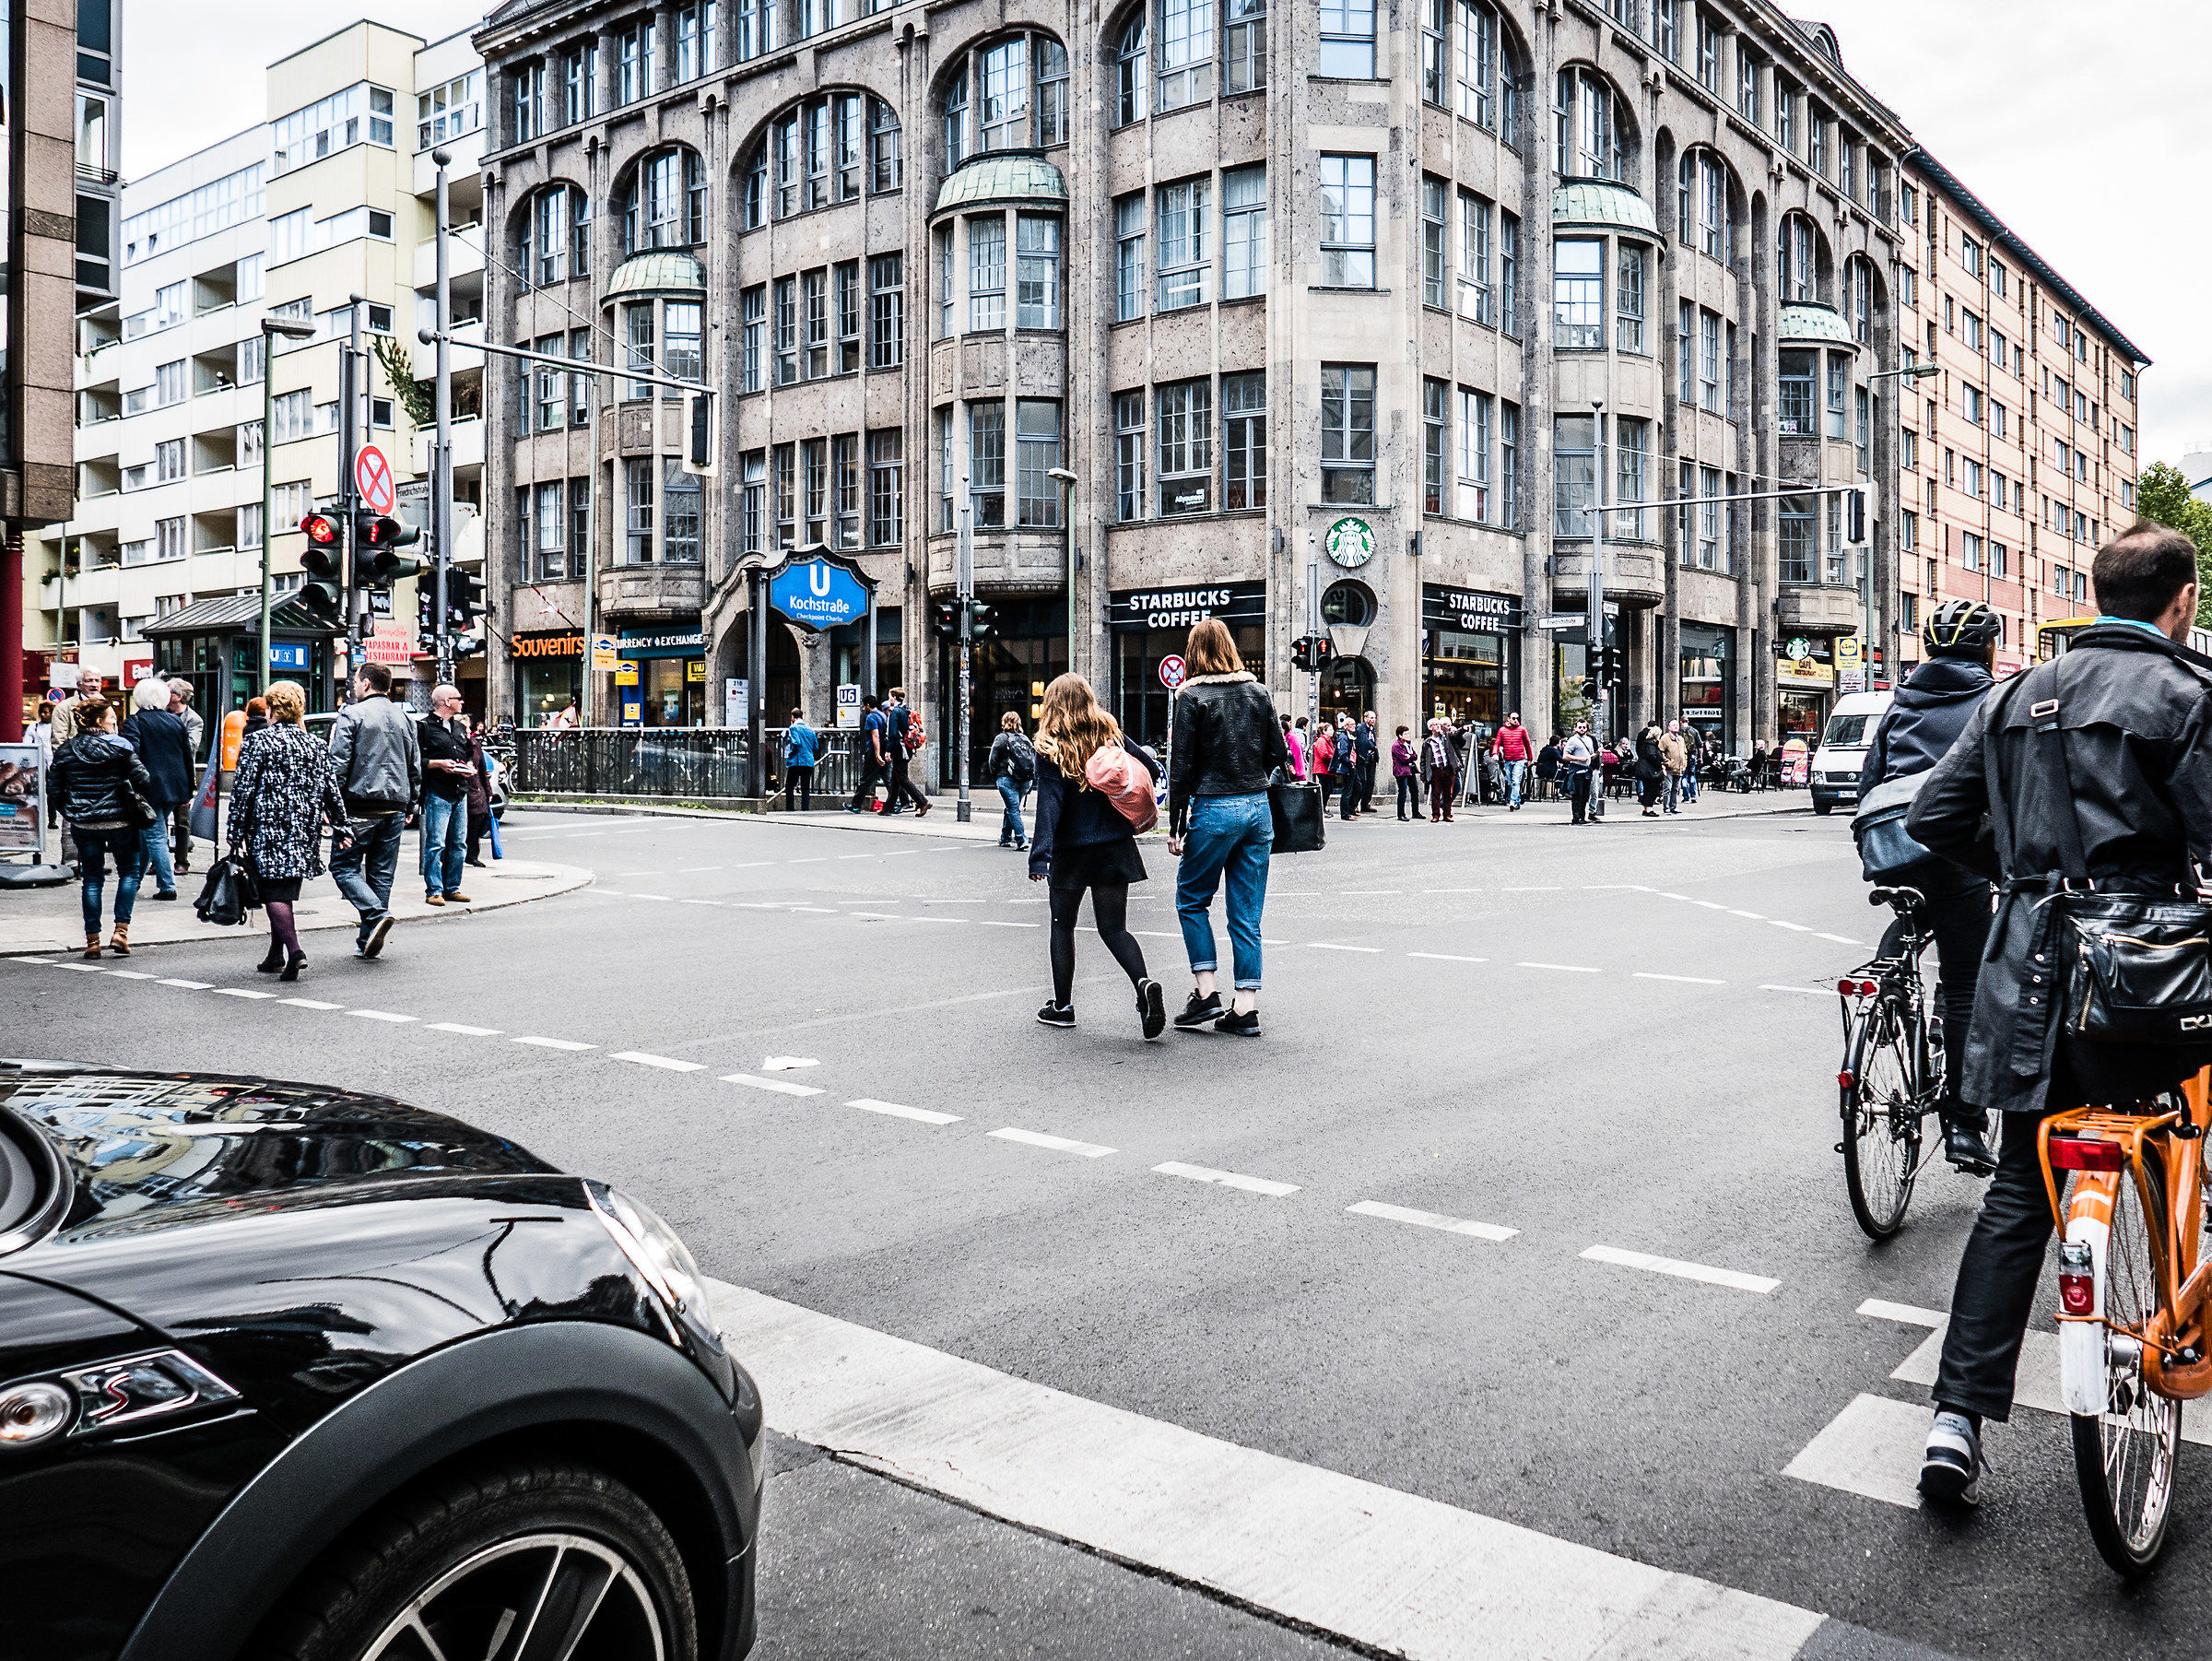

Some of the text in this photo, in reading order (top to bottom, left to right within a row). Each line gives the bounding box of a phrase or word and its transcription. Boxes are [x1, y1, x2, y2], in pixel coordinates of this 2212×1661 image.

[809, 564, 830, 597] U
[790, 595, 850, 613] Kochstraße
[1130, 589, 1230, 610] STARBUCKS
[1450, 593, 1510, 615] STARBUCKS
[796, 612, 825, 621] Checkpoint
[1461, 614, 1500, 632] COFFEE
[363, 641, 408, 651] TAPASBAR &
[512, 632, 584, 658] Souvenirs
[616, 633, 703, 650] URRENCY EXCHANGE
[840, 689, 855, 702] U6
